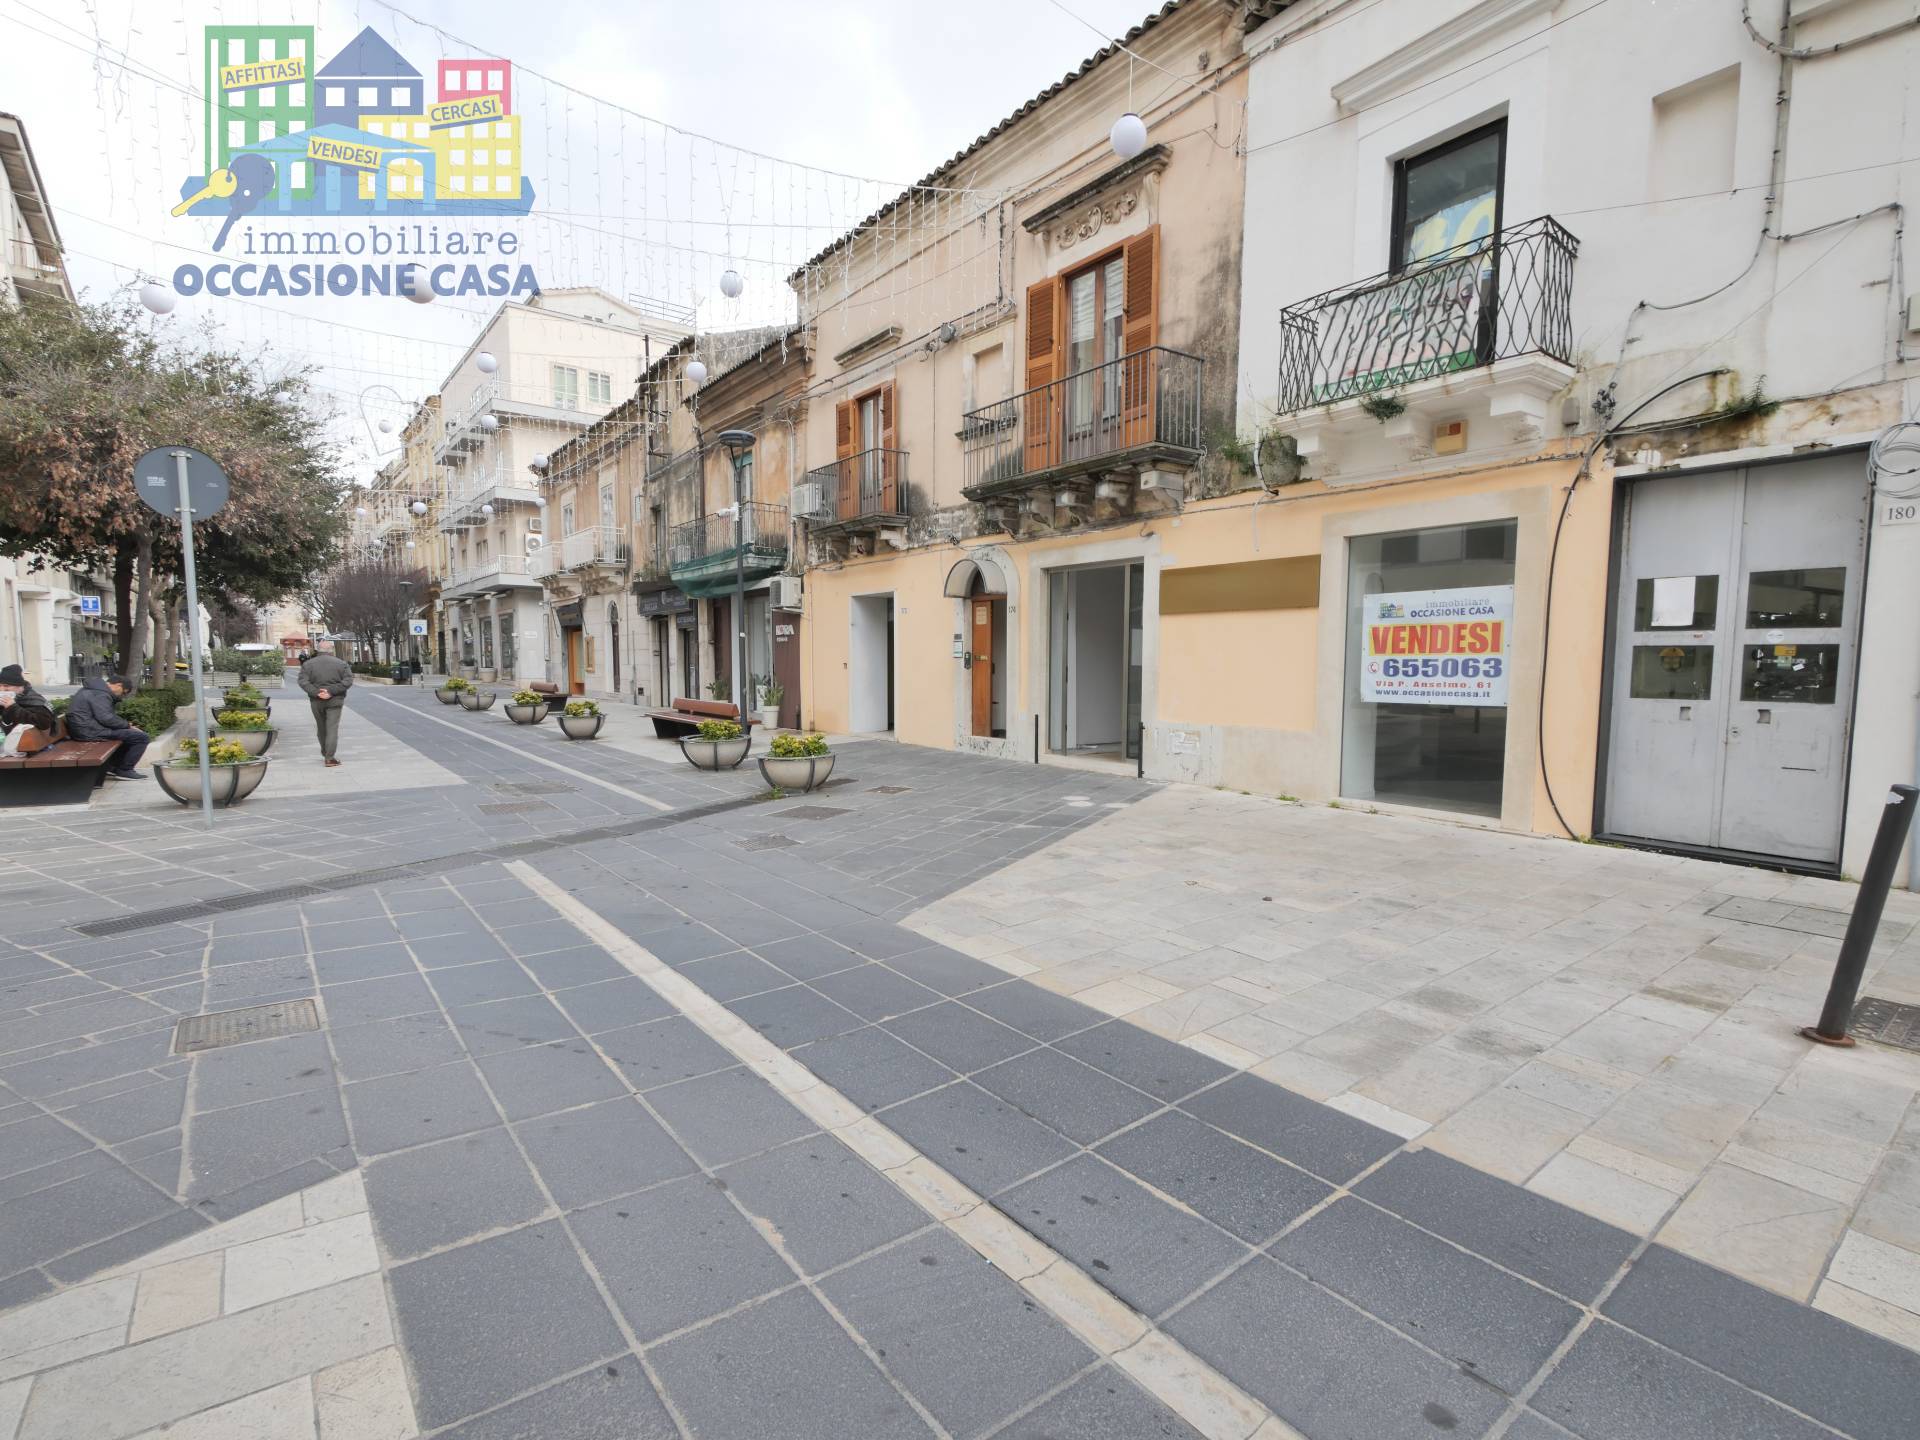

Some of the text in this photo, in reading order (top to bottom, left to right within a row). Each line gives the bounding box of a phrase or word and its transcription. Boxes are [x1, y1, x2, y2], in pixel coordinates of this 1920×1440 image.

[1888, 505, 1916, 521] 180
[1425, 598, 1490, 609] immobiliare
[1410, 606, 1495, 618] OCCASIONE CASA
[1371, 622, 1501, 654] VENDESI
[1383, 658, 1503, 678] 655063
[1476, 681, 1492, 689] 61
